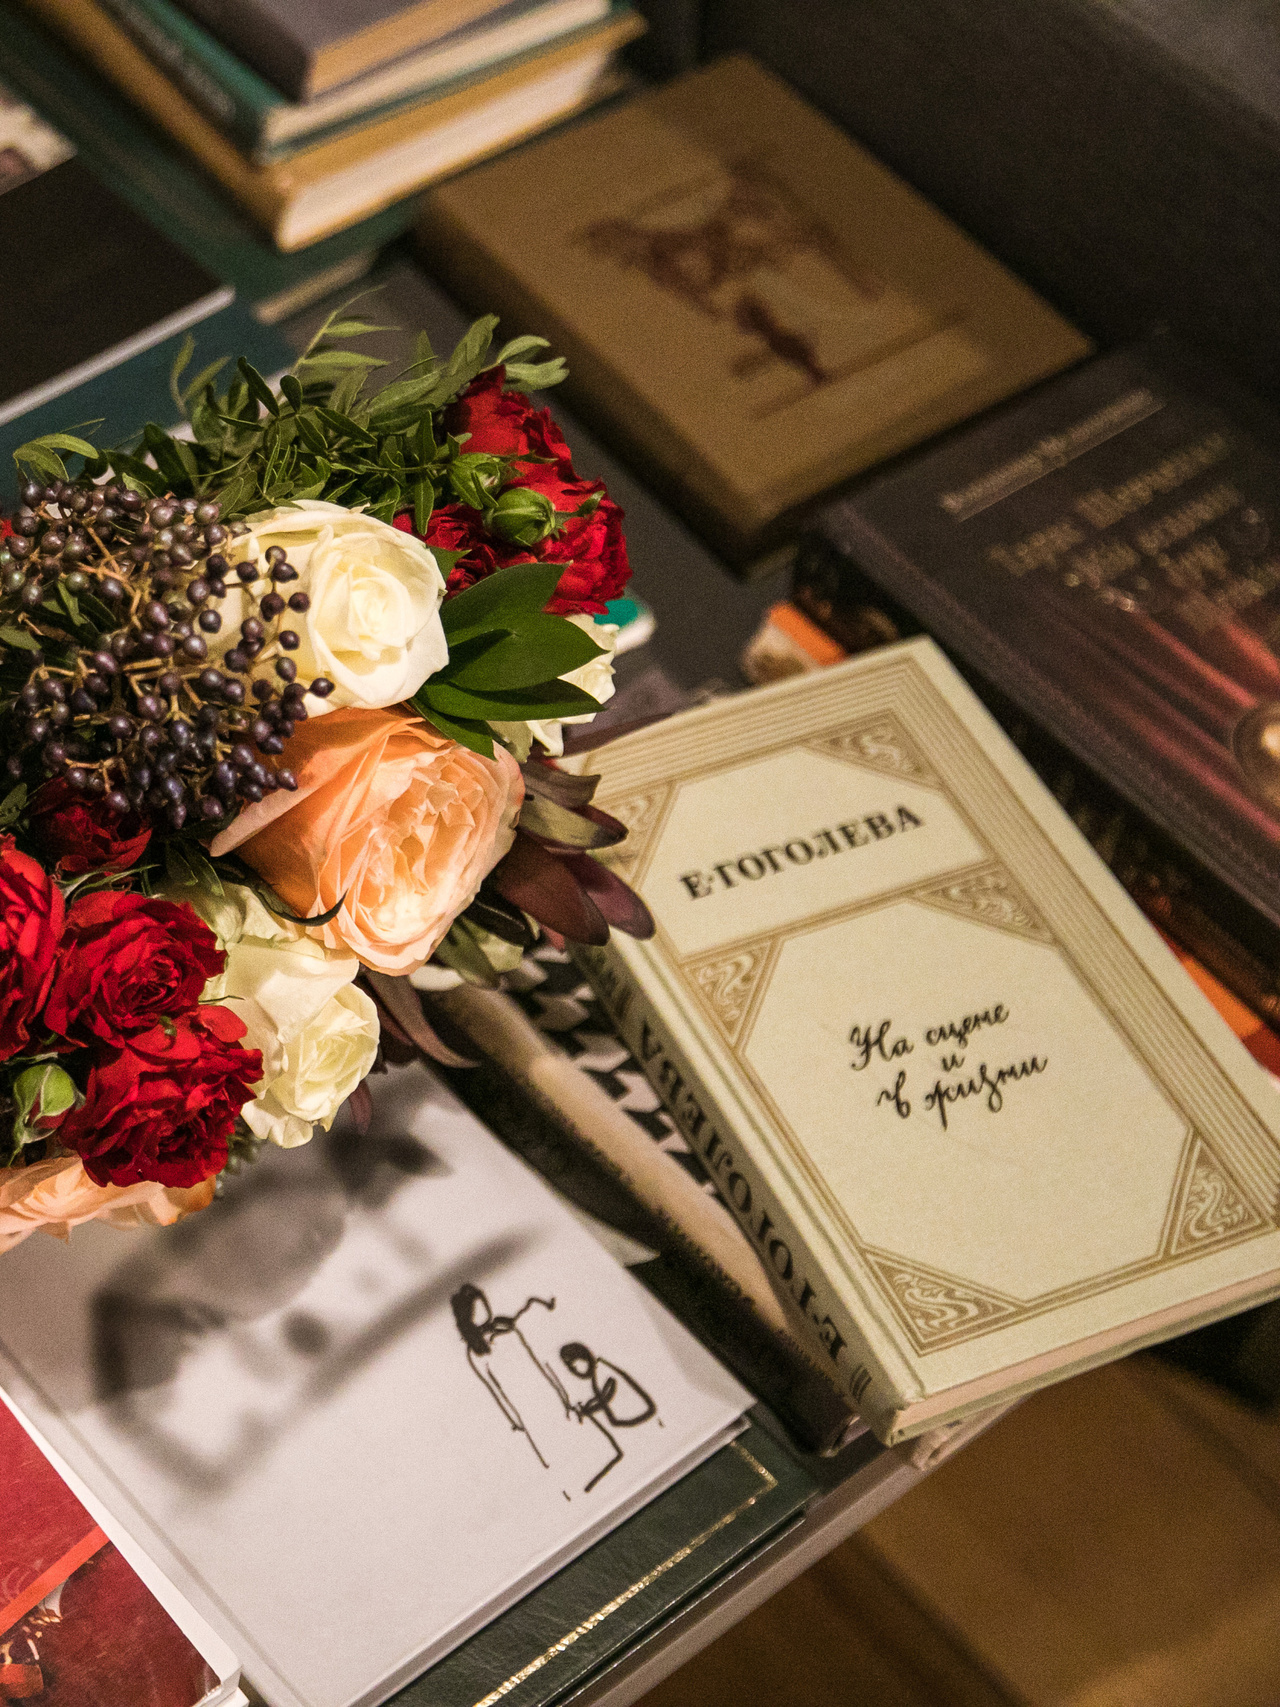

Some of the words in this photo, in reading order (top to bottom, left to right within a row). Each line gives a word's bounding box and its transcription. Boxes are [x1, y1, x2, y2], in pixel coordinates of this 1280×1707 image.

[849, 1018, 915, 1071] На
[925, 1003, 1010, 1049] сцене
[941, 1053, 966, 1072] и
[876, 1070, 912, 1119] в
[924, 1055, 1049, 1132] жизни
